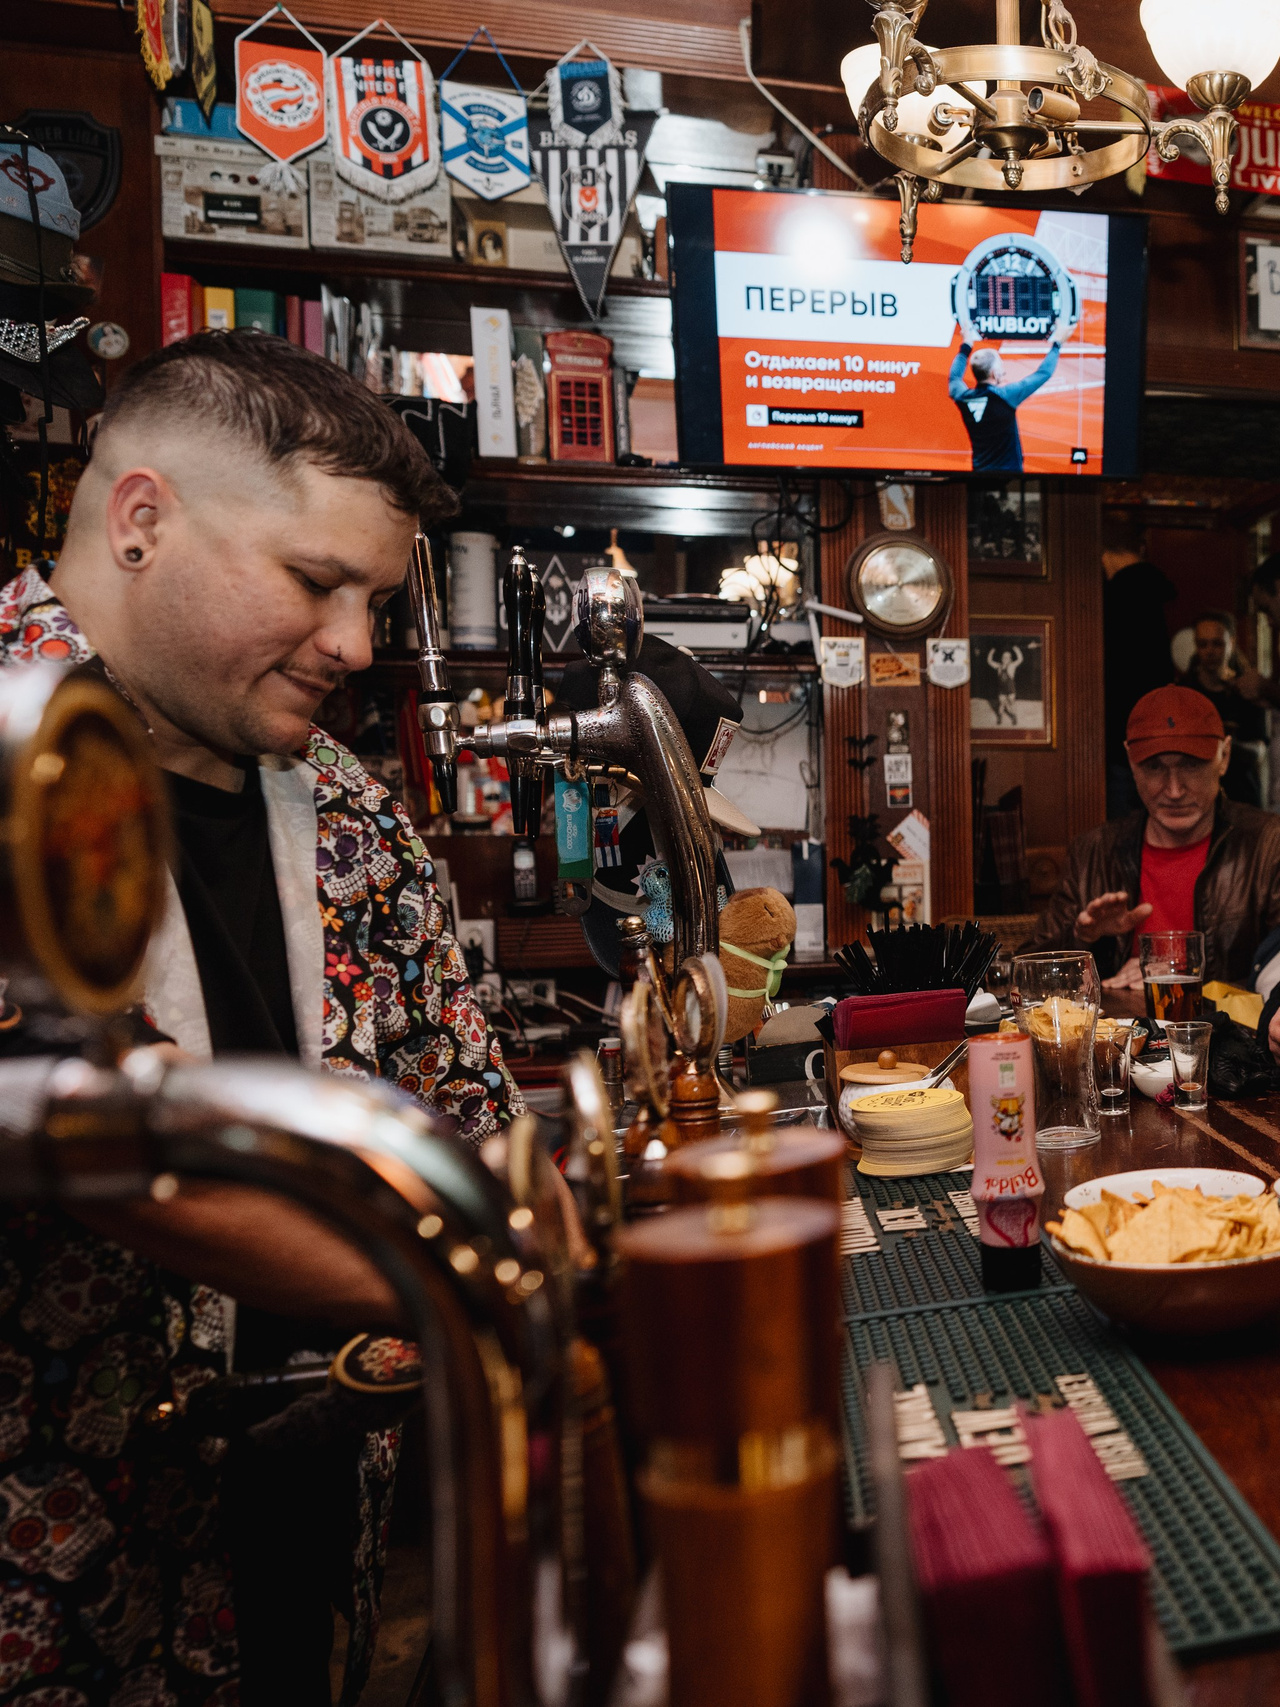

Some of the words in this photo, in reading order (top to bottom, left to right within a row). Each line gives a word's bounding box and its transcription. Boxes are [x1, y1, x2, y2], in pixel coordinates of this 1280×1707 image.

[745, 286, 898, 317] ПЕРЕРЫВ
[980, 316, 1050, 334] HUBLOT
[744, 350, 840, 371] Отдыхаем
[843, 355, 864, 372] 10
[867, 360, 921, 378] минут
[745, 374, 758, 388] и
[761, 375, 895, 394] возвращаемся
[771, 410, 817, 425] Перерыв
[817, 411, 829, 424] 10
[829, 414, 858, 426] минут
